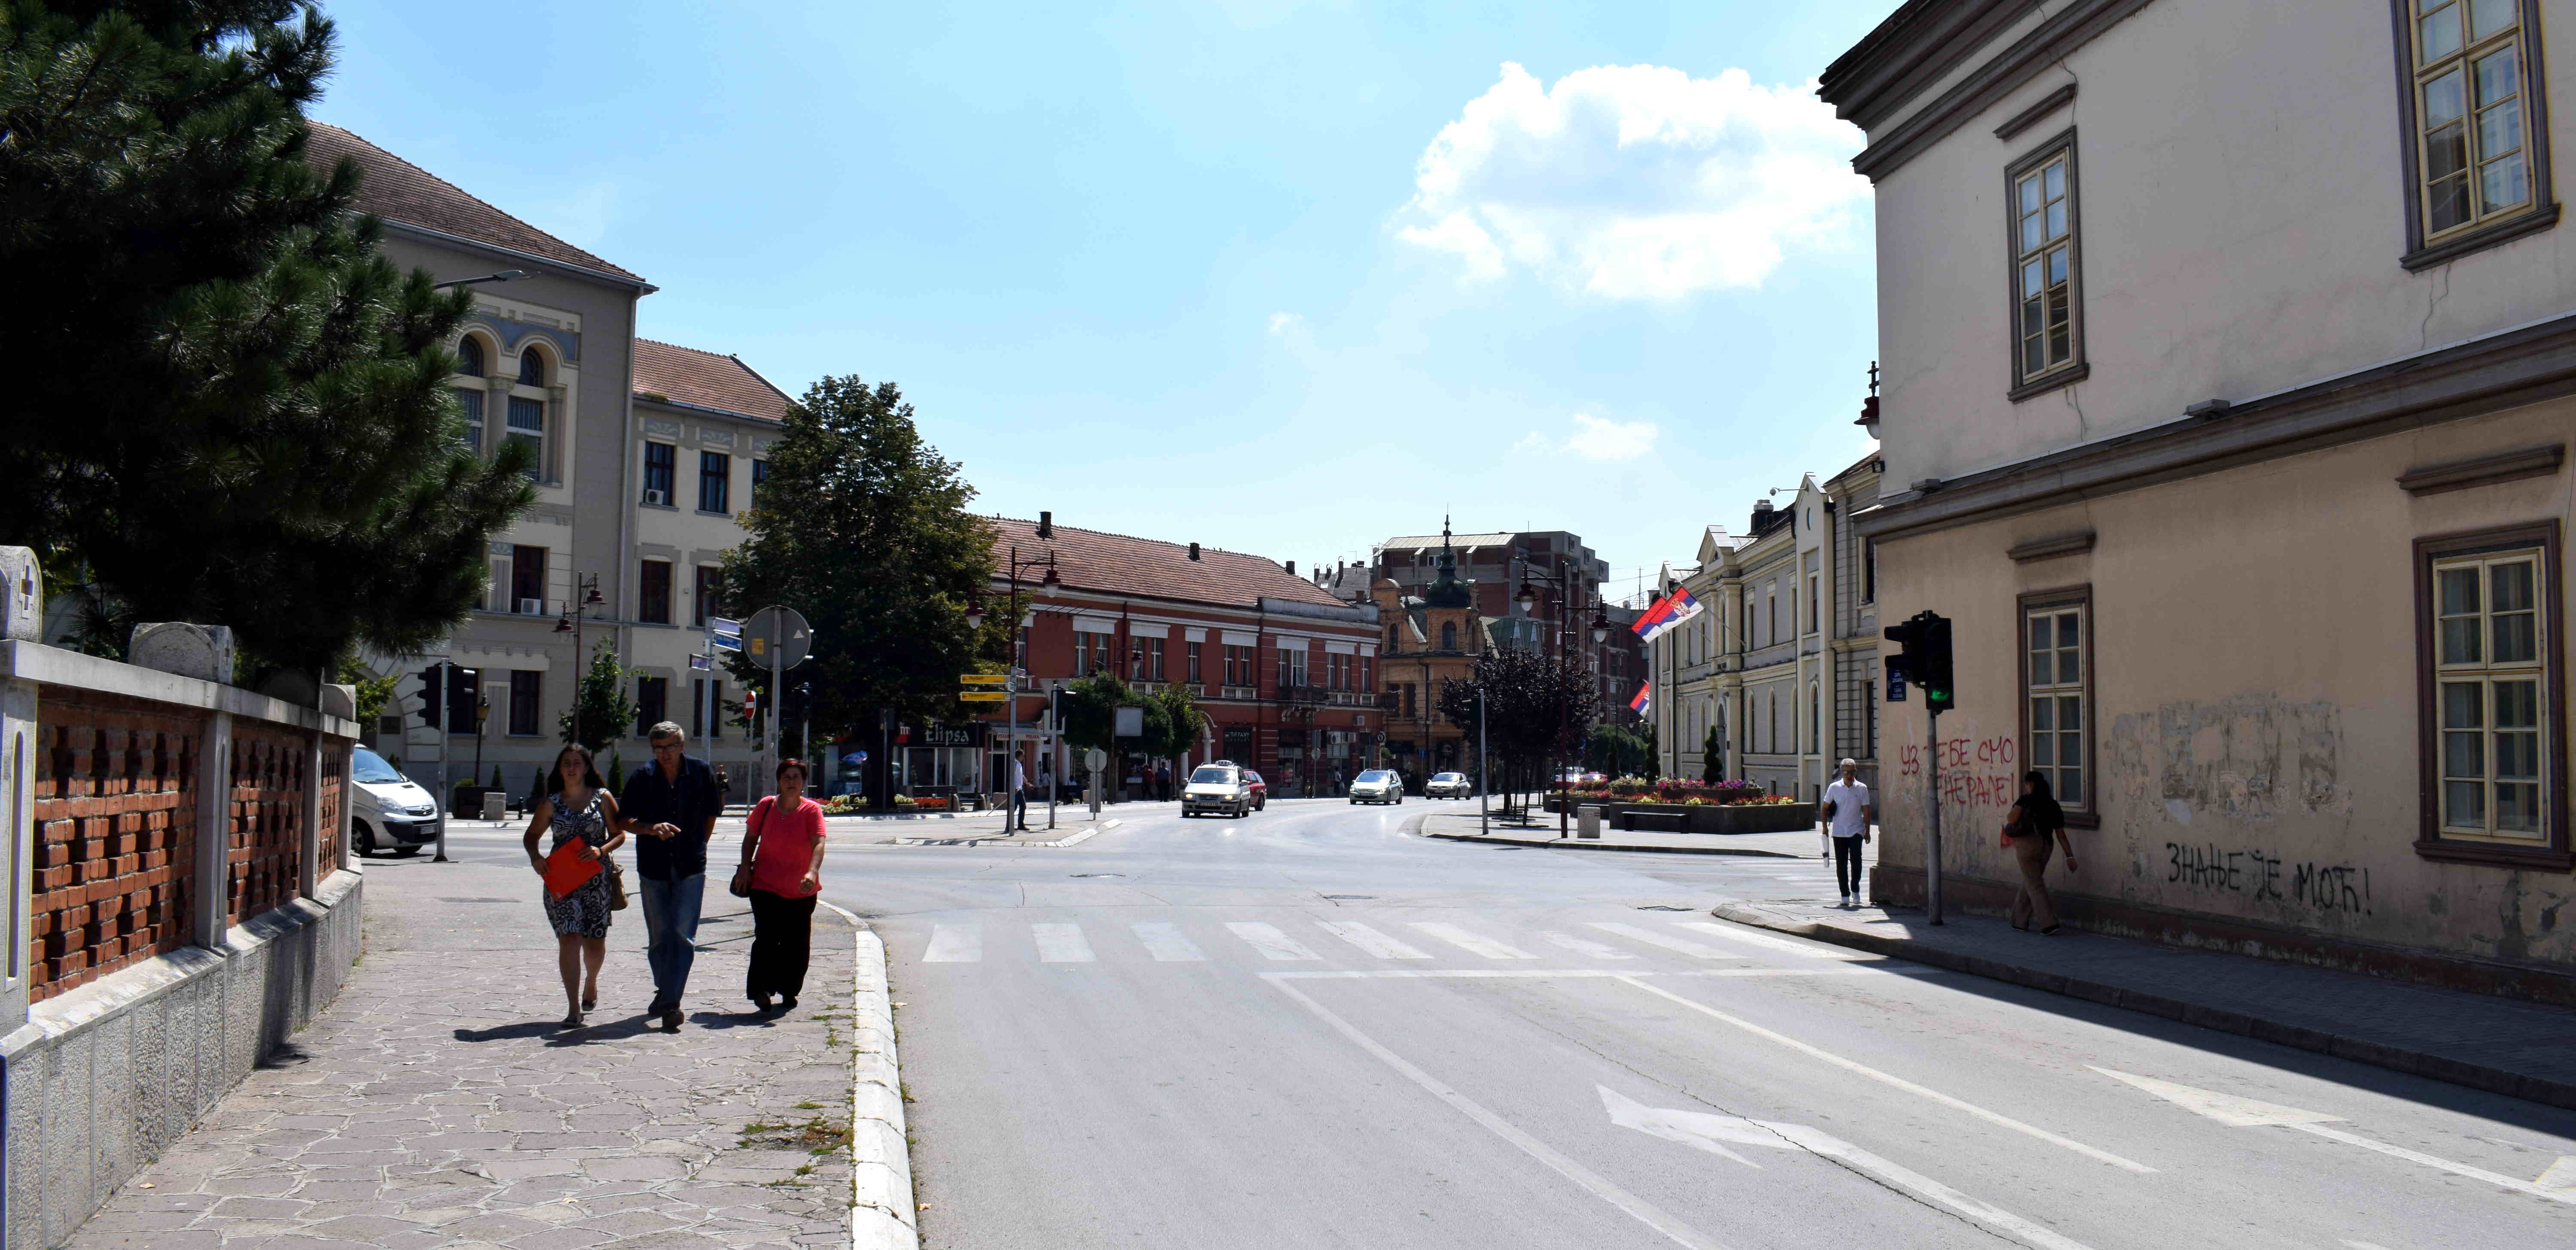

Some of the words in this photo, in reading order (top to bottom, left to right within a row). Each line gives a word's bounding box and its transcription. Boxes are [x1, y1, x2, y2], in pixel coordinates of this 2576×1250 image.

[1901, 745, 1919, 775] УЗ
[1923, 739, 1971, 771] ЕБЕ
[1978, 736, 2014, 765] СМО
[2166, 843, 2243, 891] ЗНАЊЕ
[2249, 850, 2282, 900] ЈЕ
[2297, 862, 2371, 916] МОЋ!
